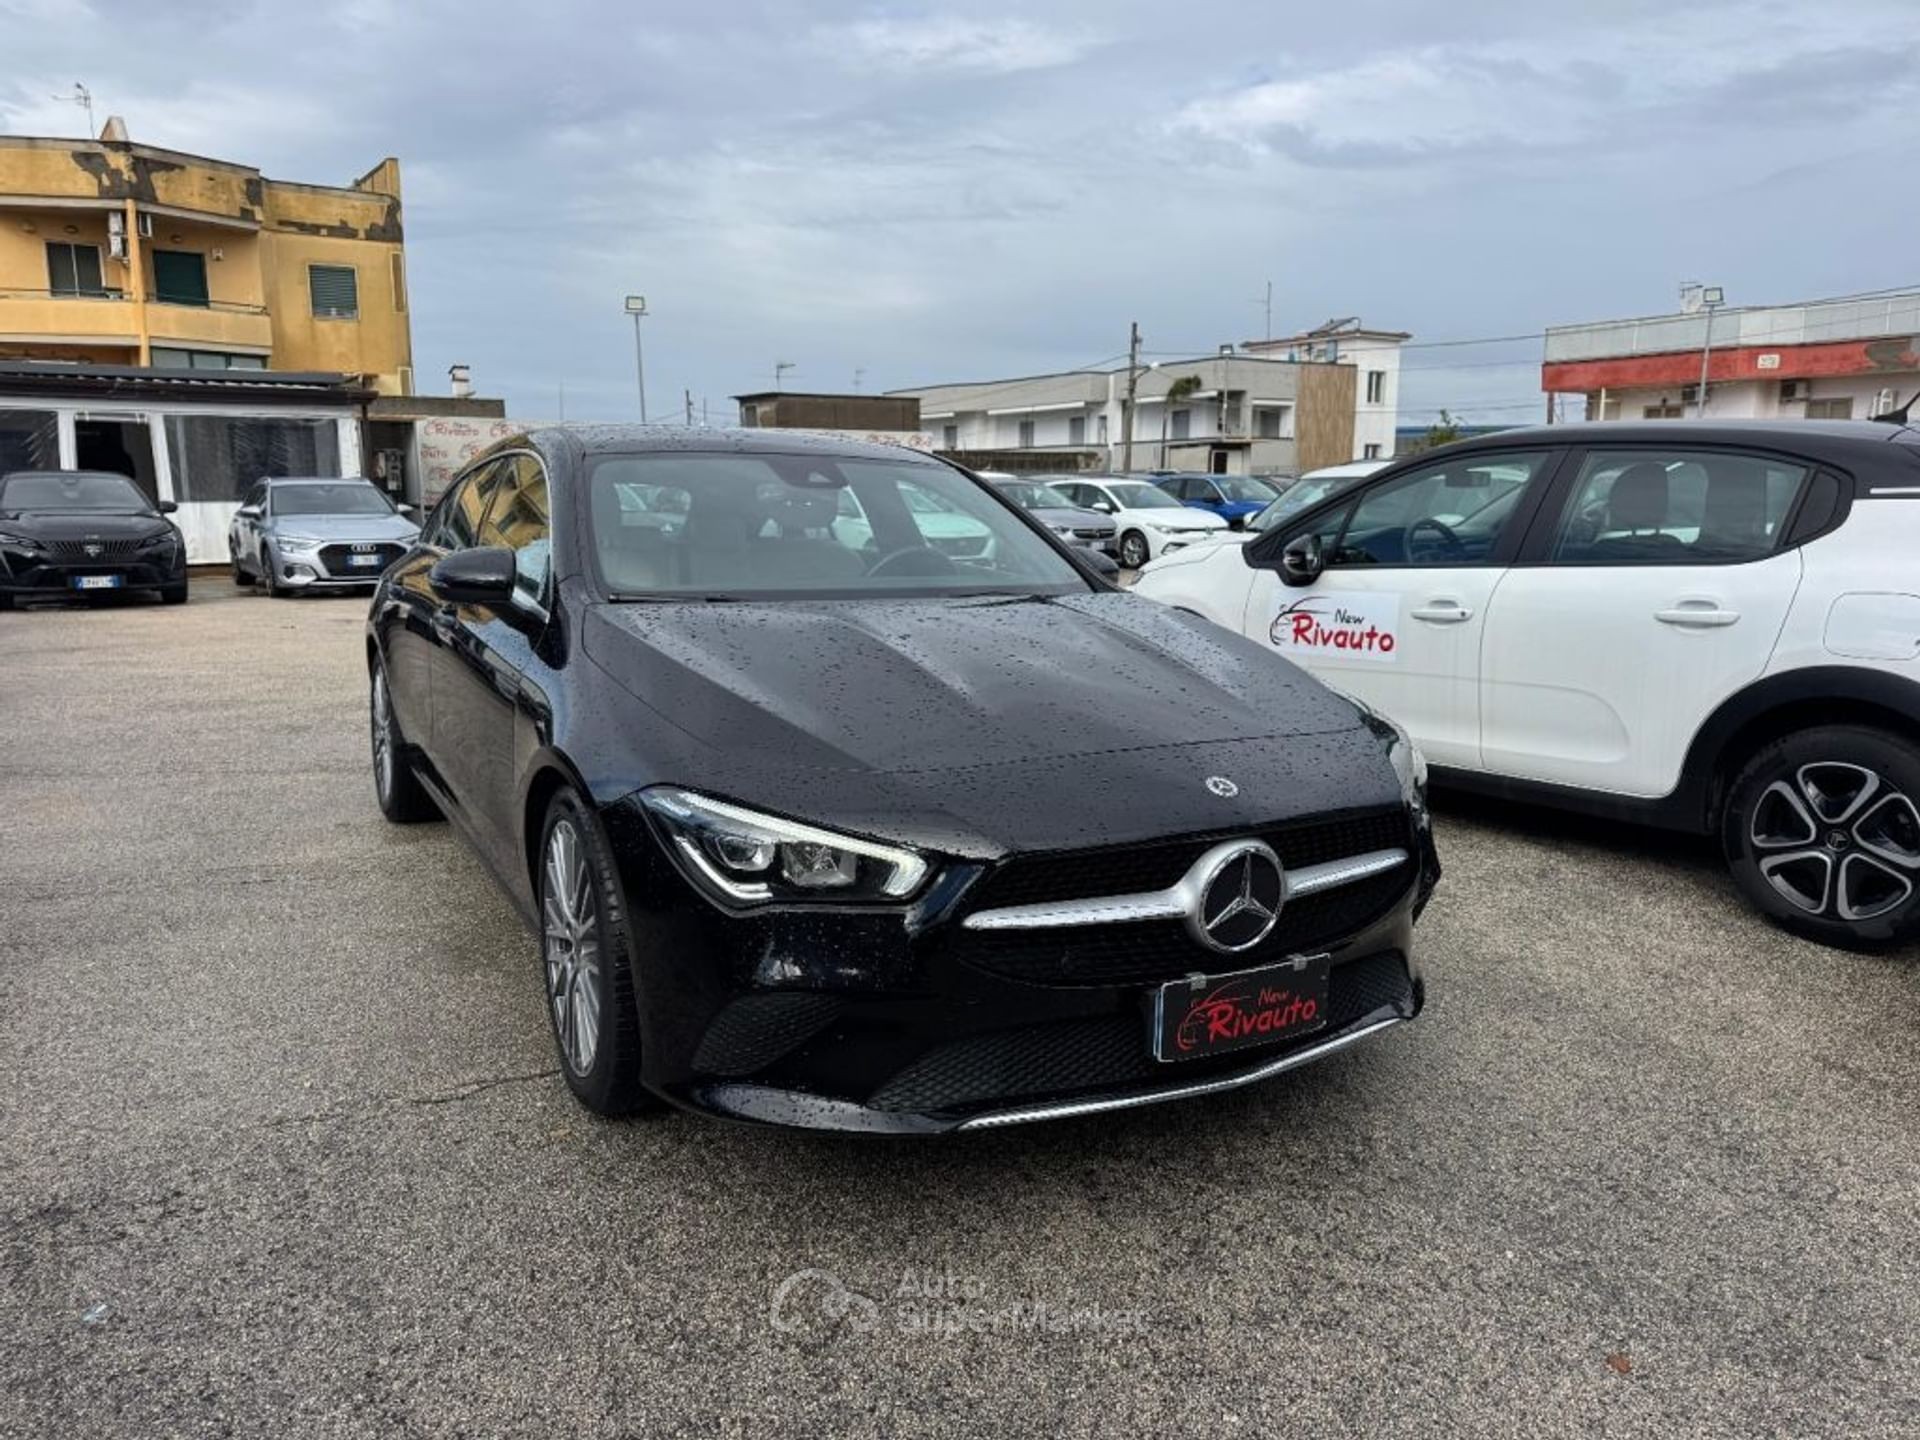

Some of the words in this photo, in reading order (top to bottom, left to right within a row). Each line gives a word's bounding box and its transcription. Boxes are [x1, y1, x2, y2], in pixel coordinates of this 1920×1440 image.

[1334, 609, 1365, 624] New
[1292, 613, 1394, 651] Rivauto
[1258, 988, 1290, 1006] New
[1207, 997, 1316, 1043] Rivauto
